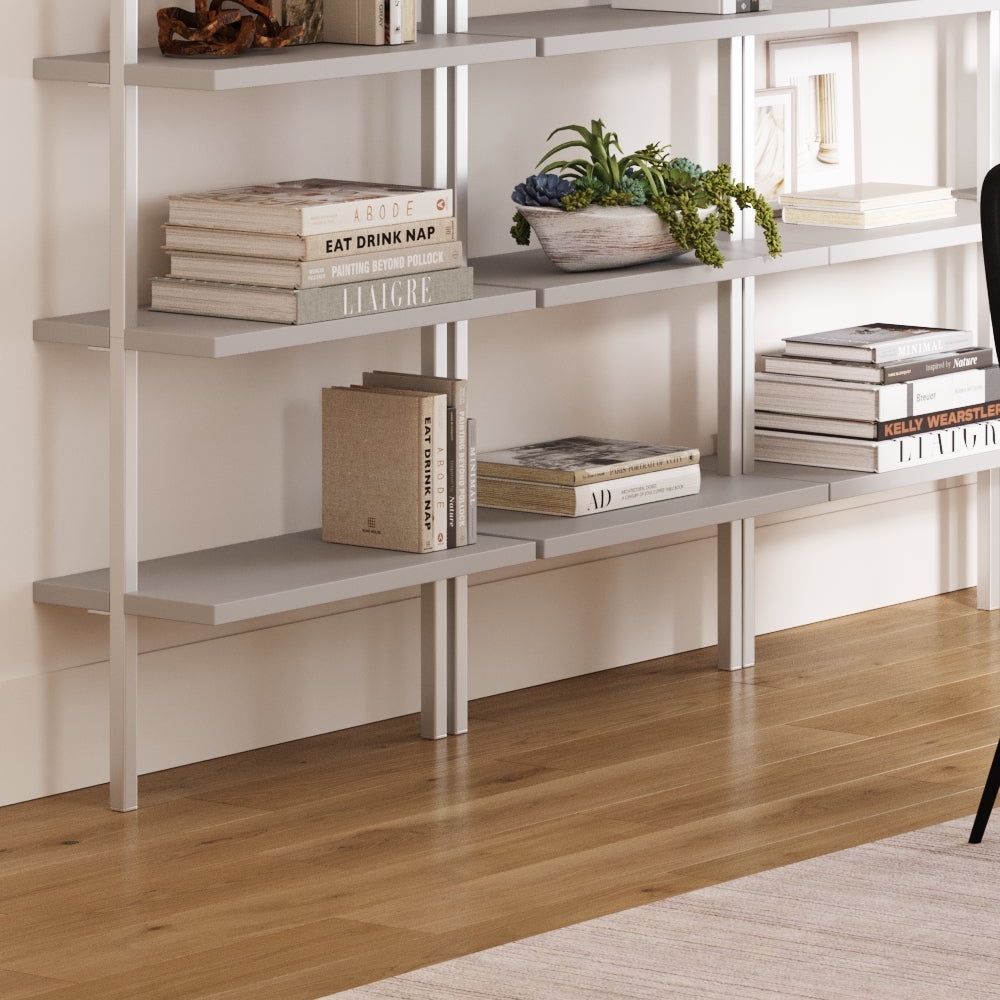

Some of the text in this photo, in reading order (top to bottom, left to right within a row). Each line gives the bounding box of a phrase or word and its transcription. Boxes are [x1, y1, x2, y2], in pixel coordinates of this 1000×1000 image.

[353, 200, 414, 222] ABODE
[326, 238, 352, 253] EAT
[356, 230, 402, 249] DRINK
[406, 226, 436, 242] NAP
[331, 263, 370, 278] PAINTING
[372, 257, 404, 272] BEYOND
[407, 251, 444, 266] POLLOCK
[343, 276, 432, 315] LIAIGRE
[897, 339, 944, 358] MINIMAL
[925, 362, 945, 372] Inspired
[953, 355, 978, 368] Nature
[884, 416, 924, 437] KELLY
[587, 488, 612, 512] AD
